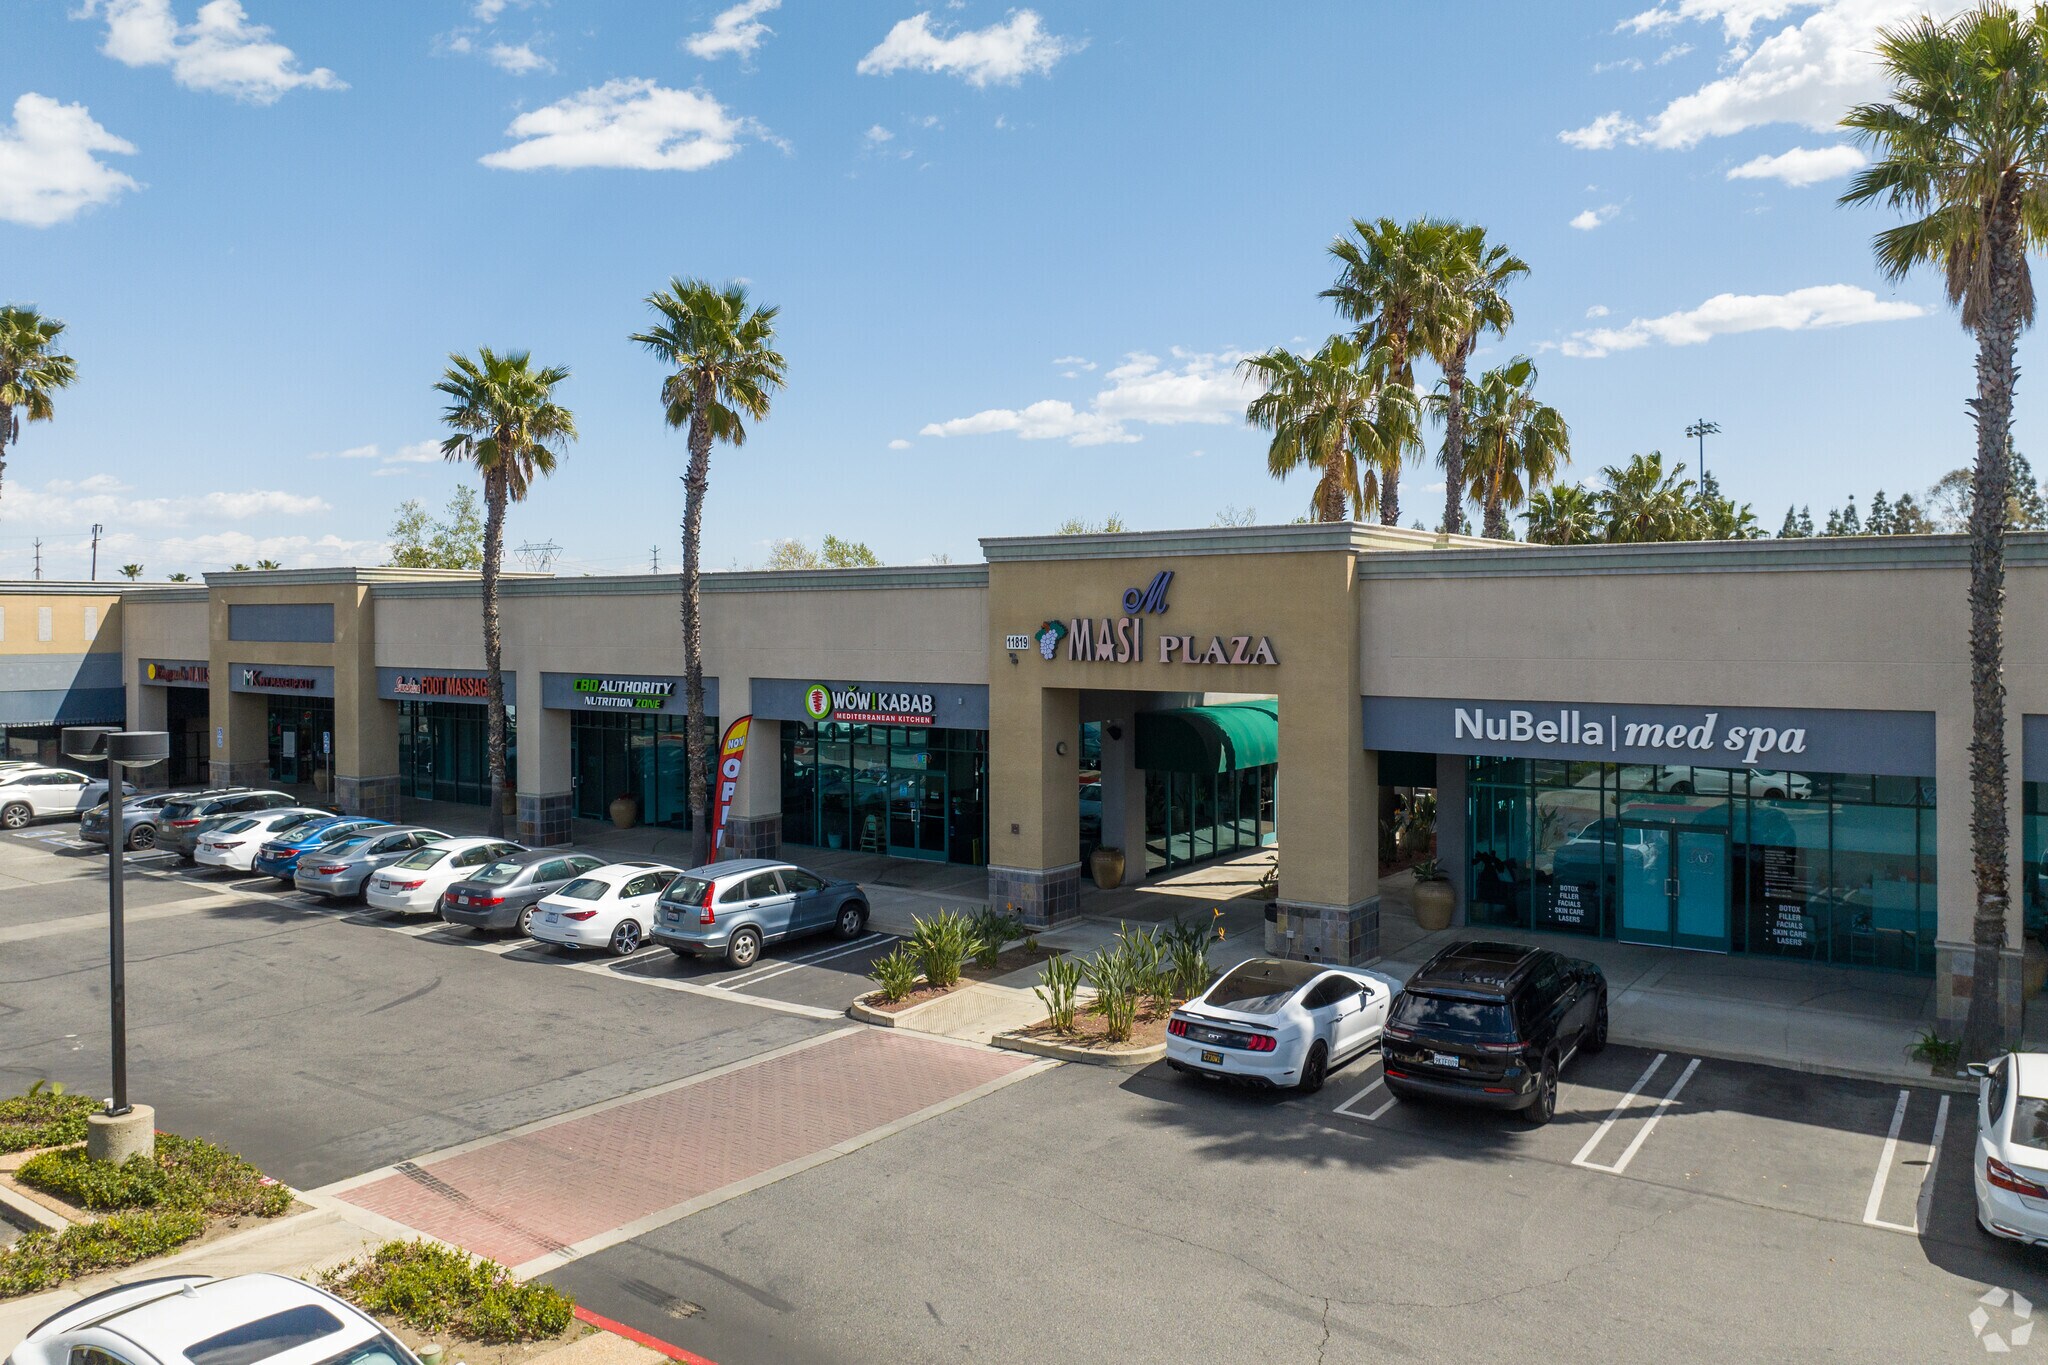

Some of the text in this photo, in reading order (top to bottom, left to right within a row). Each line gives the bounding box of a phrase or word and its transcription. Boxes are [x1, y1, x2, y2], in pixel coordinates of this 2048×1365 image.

[1007, 636, 1028, 648] 11819
[1068, 618, 1279, 665] MASI PLAZA
[421, 676, 444, 695] FOOT
[445, 677, 489, 698] MASSAG
[573, 679, 673, 695] CBD AUTHORITY
[584, 696, 661, 709] NUTRITION ZONE
[878, 692, 933, 713] KABAB
[836, 712, 931, 723] MEDITERRANEAN KITCHEN
[1455, 708, 1807, 764] NuBella med spa
[1560, 892, 1579, 900] FILLER
[1557, 900, 1581, 908] FACIALS
[1779, 904, 1801, 913] BOTOX
[1569, 908, 1585, 916] CARE
[1778, 913, 1801, 921] FILLER
[1558, 915, 1580, 923] LASERS
[1776, 921, 1803, 930] FACIALS
[1772, 928, 1808, 938] SKIN CARE
[1777, 937, 1803, 946] LASERS
